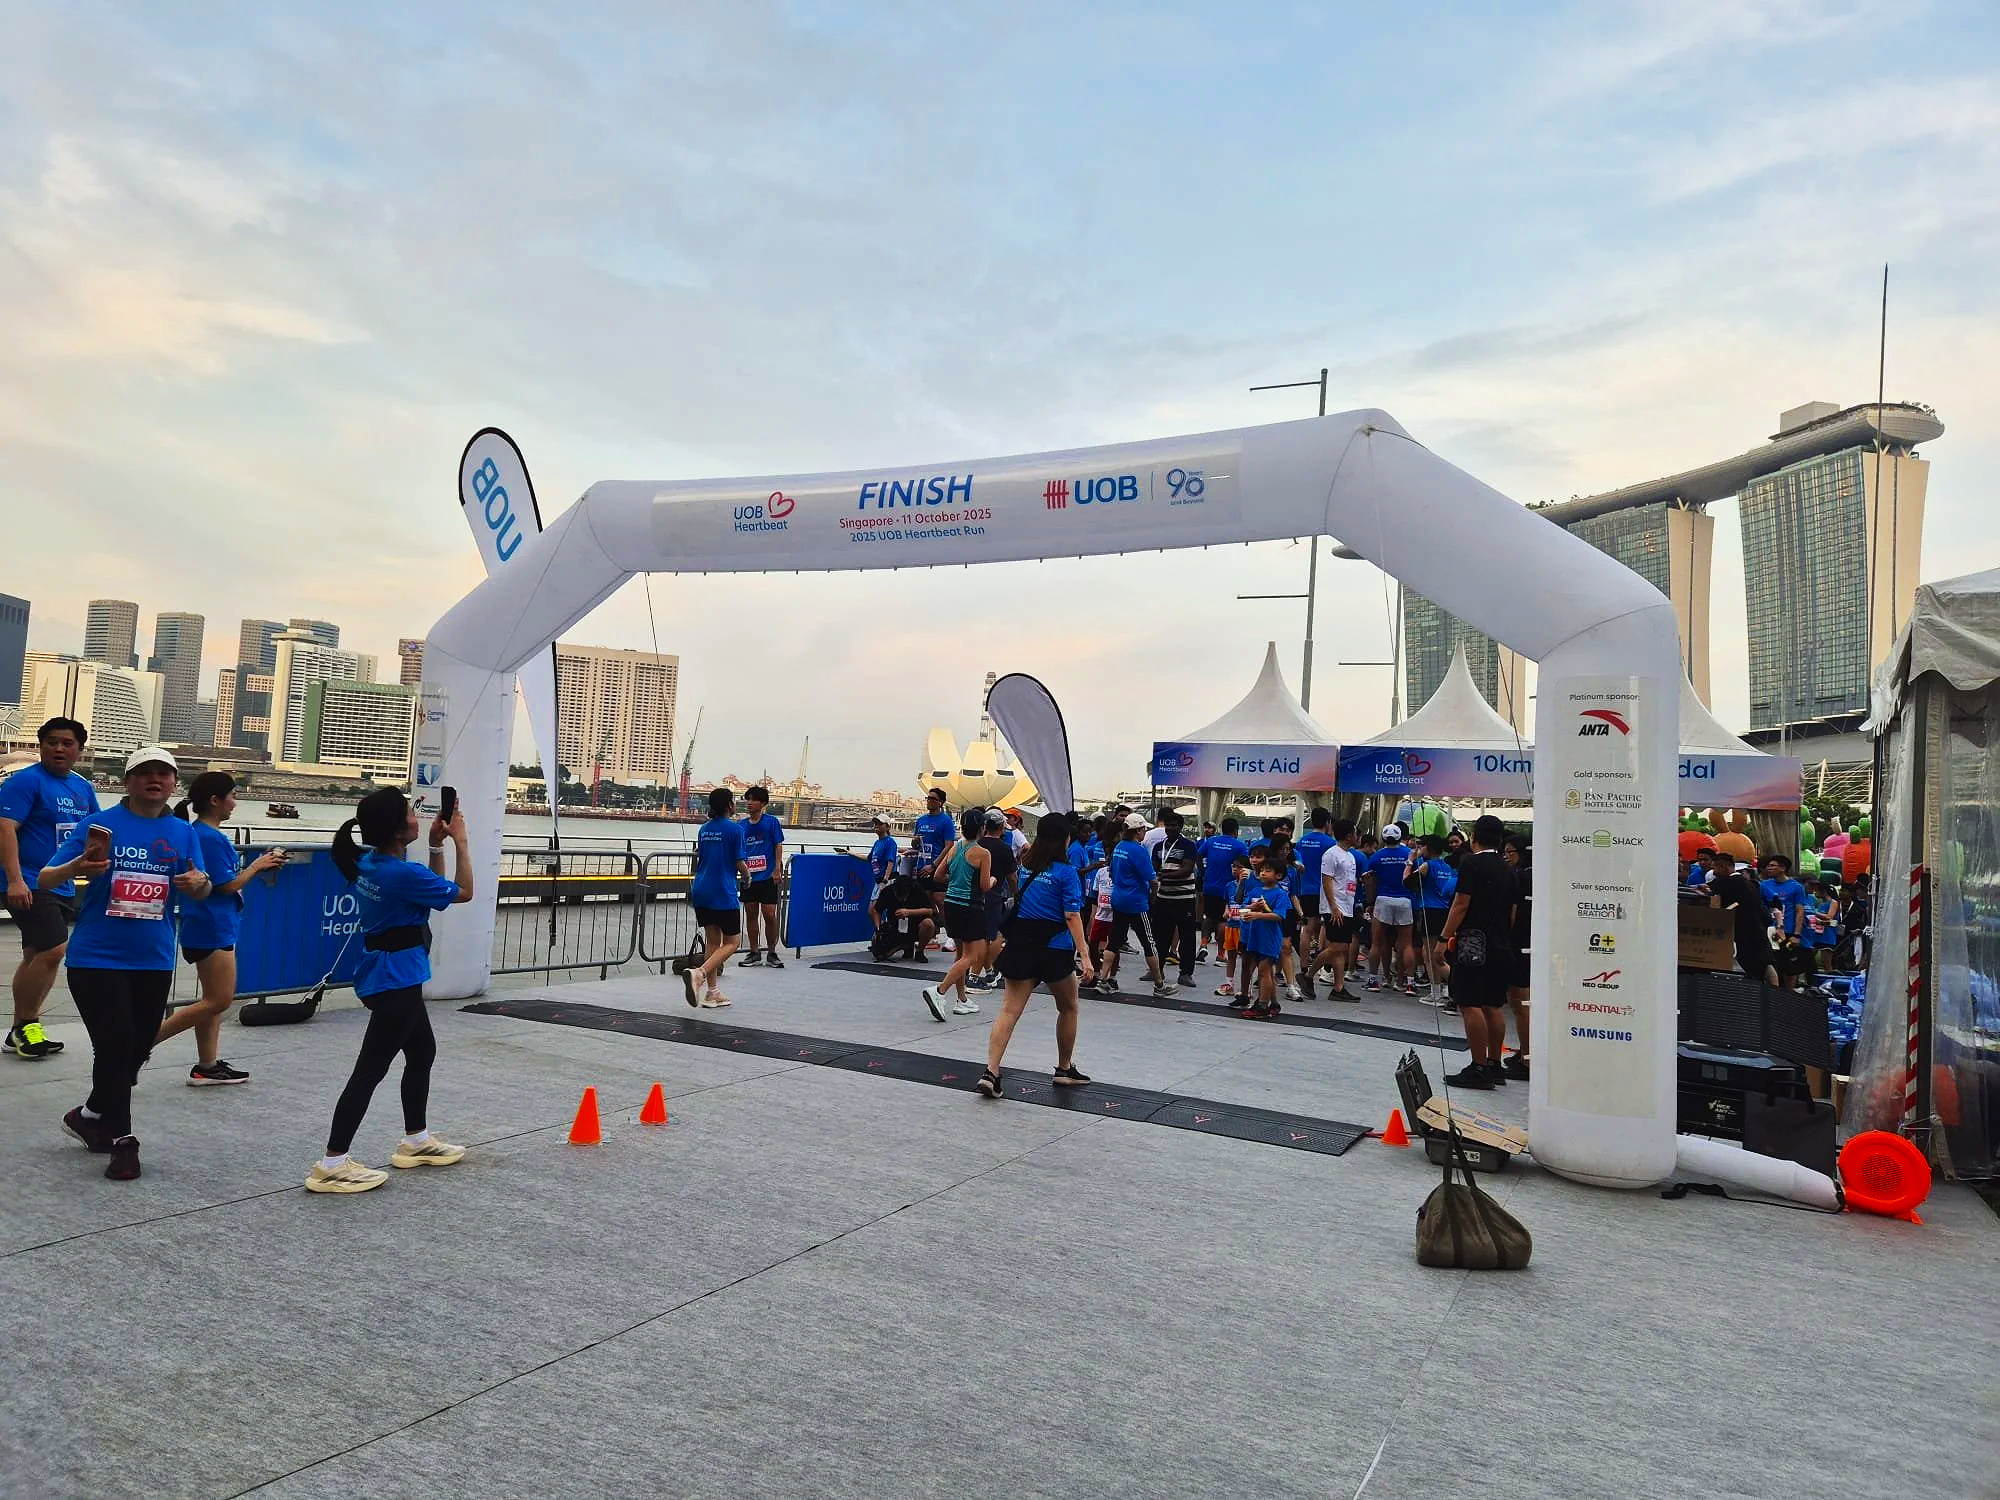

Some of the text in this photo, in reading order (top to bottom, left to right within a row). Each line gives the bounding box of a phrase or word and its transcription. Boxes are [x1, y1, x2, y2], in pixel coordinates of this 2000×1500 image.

[1166, 468, 1204, 497] 90
[858, 474, 974, 510] FINISH
[1074, 475, 1138, 505] UOB
[471, 457, 523, 562] UOB
[733, 505, 763, 519] UOB
[839, 514, 894, 529] Singapore
[902, 513, 911, 525] 11
[914, 510, 961, 524] October
[963, 507, 993, 521] 2025
[733, 519, 788, 532] Heartbeat
[850, 524, 985, 543] 2025 UOB Heartbeat Run
[1569, 693, 1641, 702] Platinum sponsor:
[1578, 723, 1610, 737] ANTA
[1226, 756, 1301, 774] First Aid
[1375, 763, 1402, 774] UOB
[1473, 754, 1716, 779] 10km dal
[1375, 774, 1425, 785] Heartbeat
[1573, 770, 1593, 778] Gold
[57, 796, 74, 807] UOB
[1584, 792, 1643, 802] PAN PACIFIC
[1584, 801, 1642, 809] HOTELS GROUP
[1562, 835, 1644, 847] SHAKE SHACK
[114, 846, 148, 860] UOB
[114, 859, 170, 873] Heartbeat
[123, 882, 163, 898] 1709
[823, 885, 845, 901] UOB
[1571, 882, 1634, 894] Silver sponsors:
[322, 894, 360, 917] UO
[823, 901, 860, 913] Heartbeat
[1577, 902, 1616, 911] CELLAR
[1567, 1001, 1622, 1015] PRUDENTIAL
[1571, 1026, 1632, 1041] SAMSUNG
